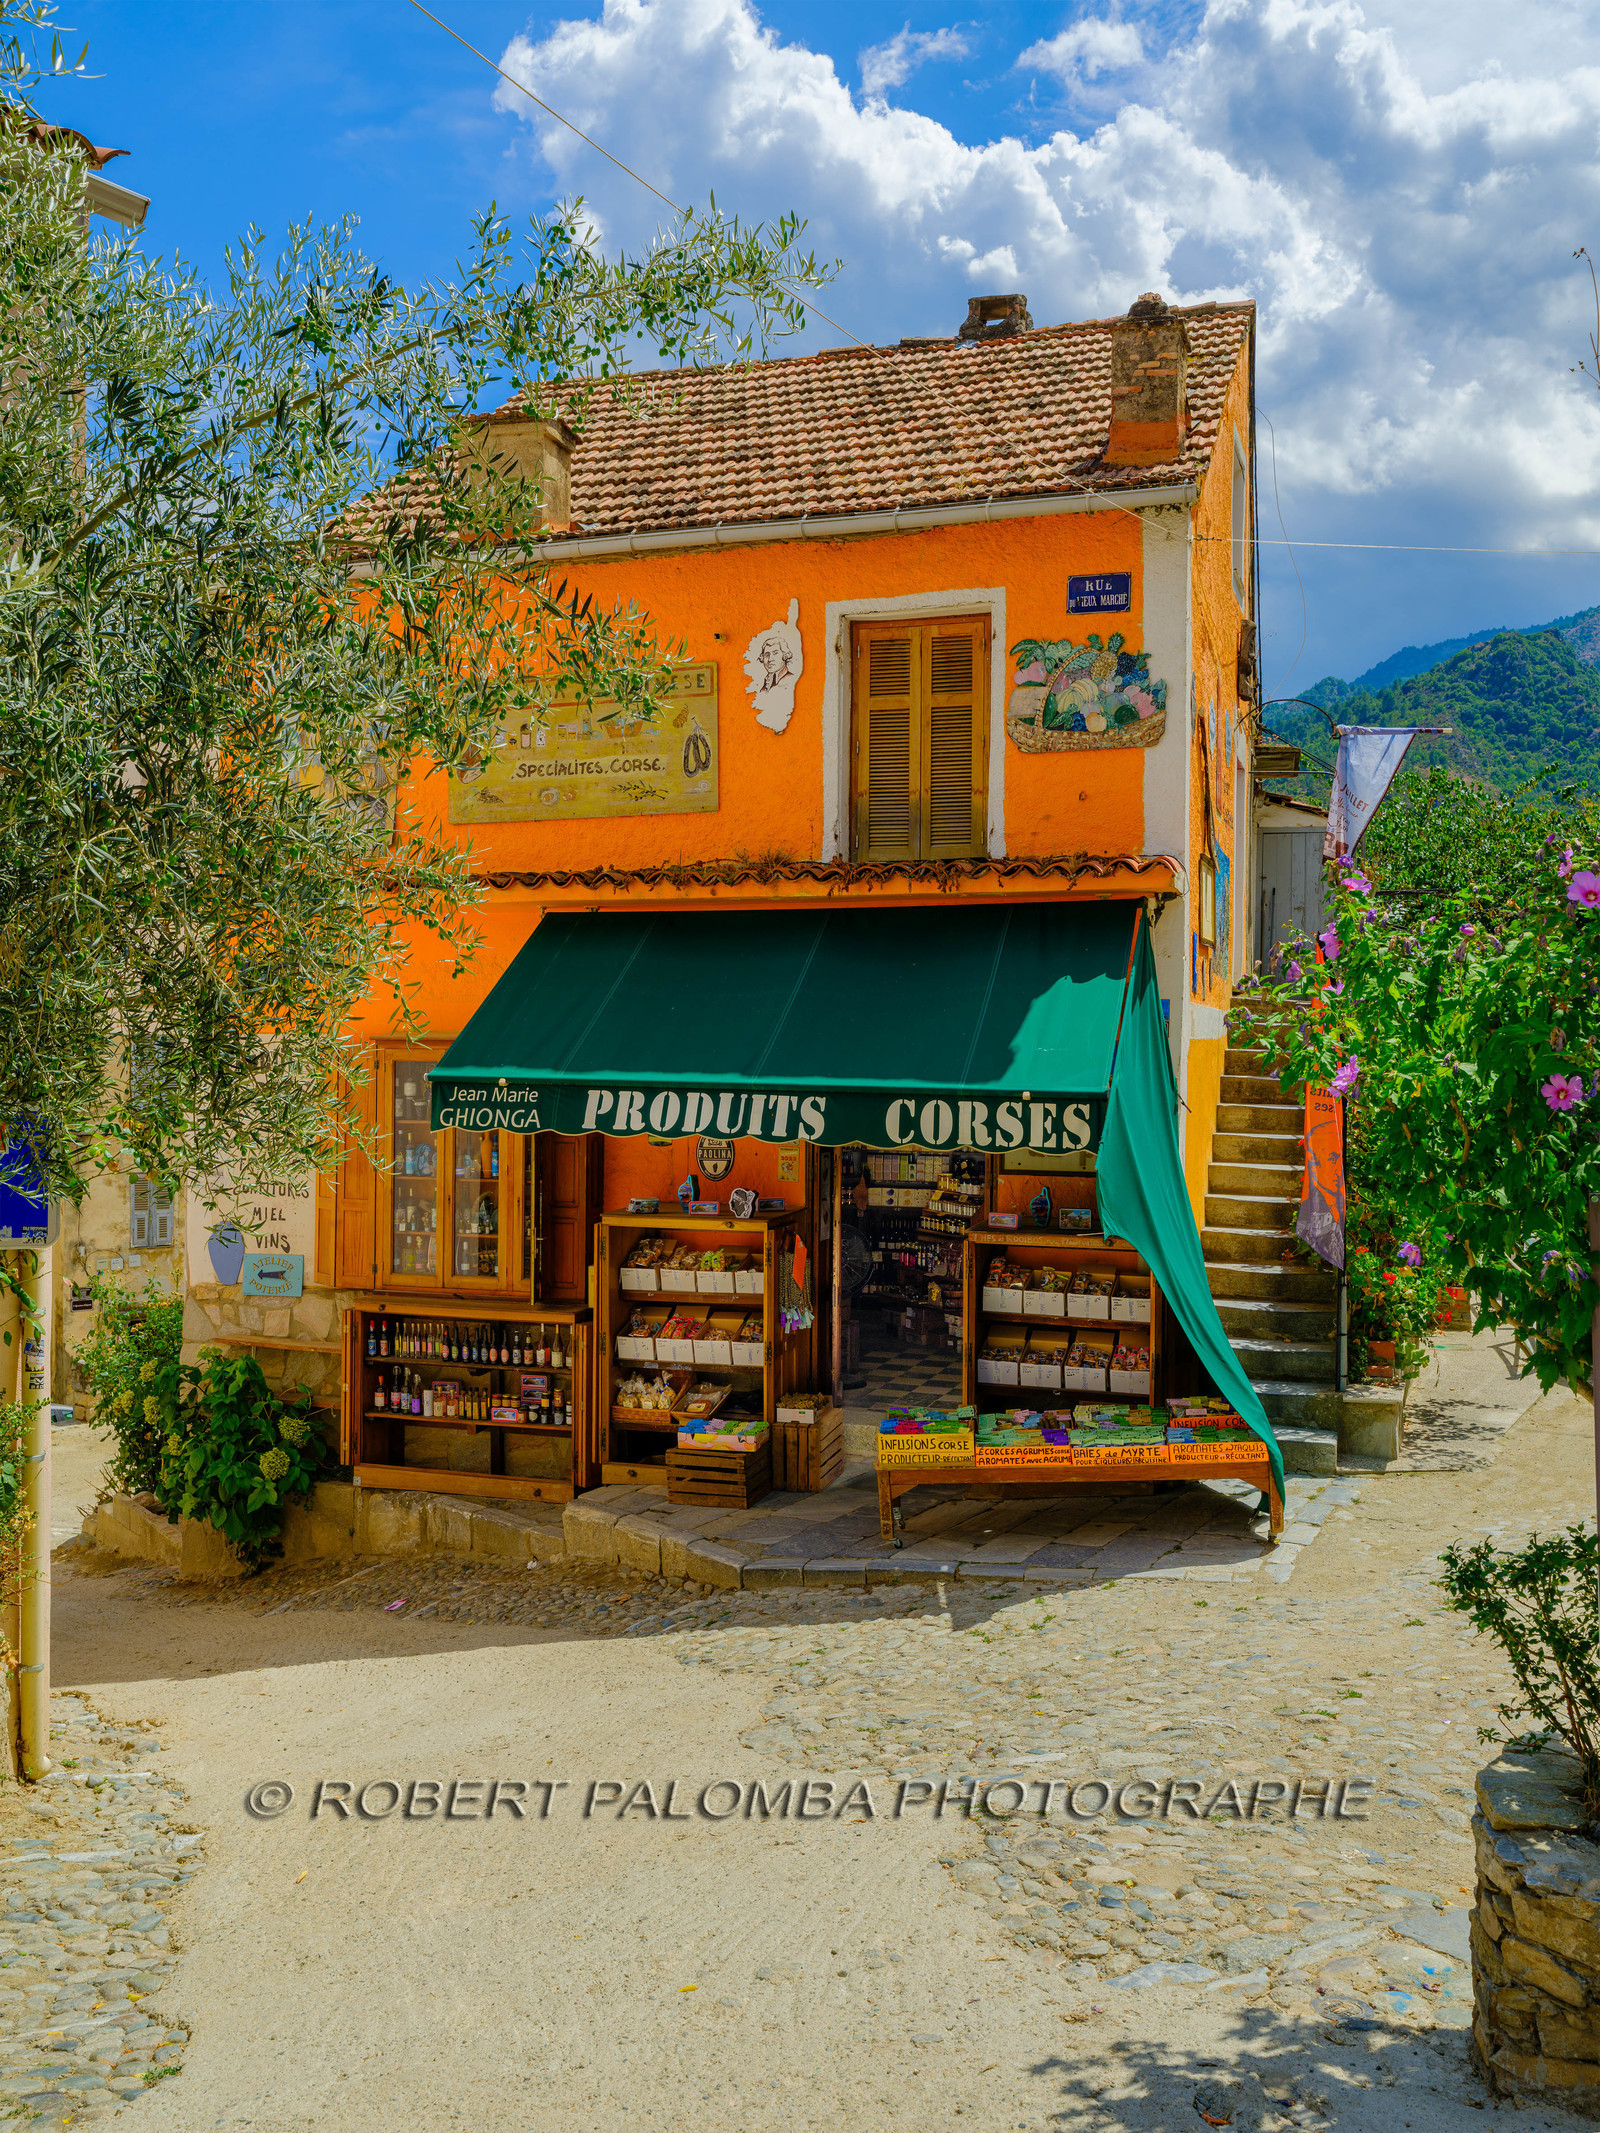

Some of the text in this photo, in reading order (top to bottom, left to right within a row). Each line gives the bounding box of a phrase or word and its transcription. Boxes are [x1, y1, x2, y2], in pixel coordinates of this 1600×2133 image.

[1085, 579, 1112, 591] RUE
[449, 1086, 539, 1102] Jean Marie
[440, 1107, 541, 1128] GHIONGA
[582, 1089, 1091, 1150] PRODUITS CORSES
[698, 1149, 732, 1159] PAOLINA
[253, 1207, 286, 1221] MIEL
[256, 1232, 291, 1254] VINS
[252, 1256, 294, 1272] ATELIER
[249, 1278, 293, 1294] POTERIE
[1225, 1417, 1245, 1427] COR
[938, 1440, 970, 1450] CORSE
[1121, 1447, 1161, 1457] MYRTE
[1172, 1443, 1224, 1454] AROMATES
